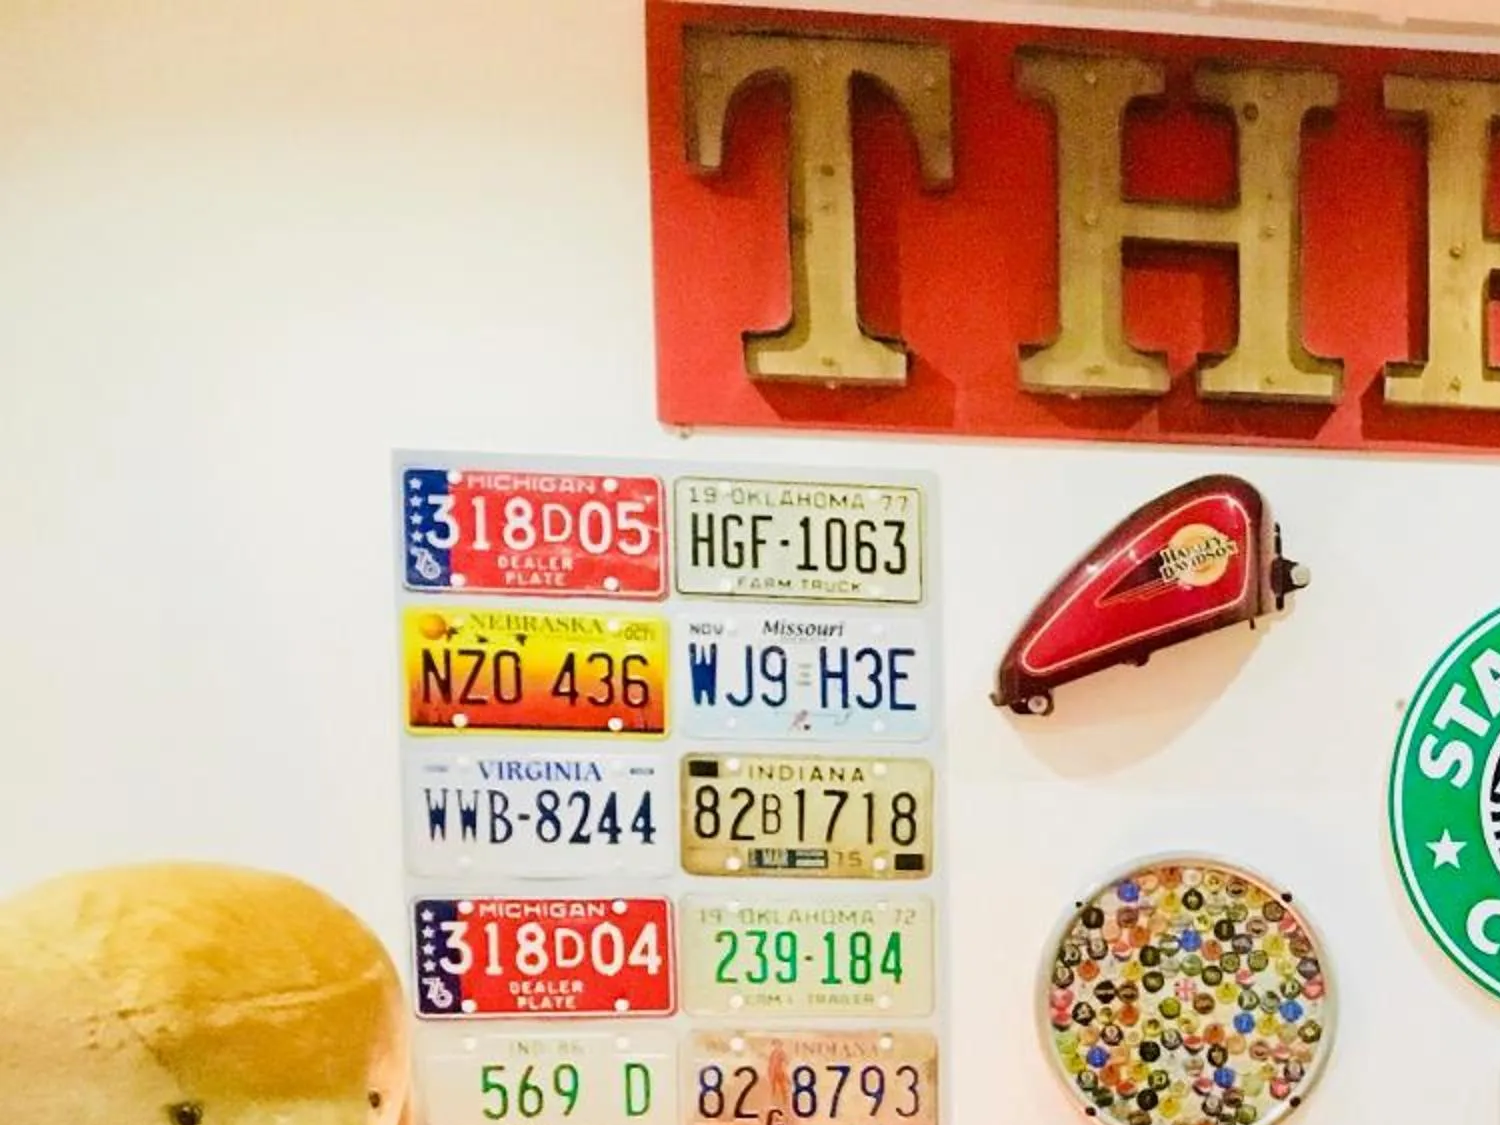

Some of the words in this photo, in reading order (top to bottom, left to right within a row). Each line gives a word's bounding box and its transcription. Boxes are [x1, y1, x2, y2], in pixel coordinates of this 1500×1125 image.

[467, 475, 596, 493] MICHIGAN
[689, 486, 717, 504] 19
[731, 490, 865, 509] OKLAHOMA
[881, 495, 907, 512] 77
[427, 495, 650, 555] 318D05
[691, 512, 906, 575] HGF-1063
[498, 556, 573, 570] DEALER
[506, 572, 567, 585] PLATE
[737, 577, 791, 589] FARM
[801, 580, 862, 593] TRUCK
[470, 614, 603, 634] NEBRASKA
[690, 624, 724, 635] NOV
[762, 620, 845, 637] Missouri
[551, 651, 651, 708] 436
[688, 643, 788, 708] WJ9
[819, 646, 917, 710] H3E
[478, 760, 602, 781] VIRGINIA
[748, 764, 866, 783] INDIANA
[424, 788, 656, 844] WWB-8244
[694, 784, 918, 846] 82B1718
[480, 903, 605, 918] MICHIGAN
[741, 909, 874, 924] OKLAHOMA
[440, 922, 662, 976] 318D04
[715, 931, 903, 984] 239-184
[509, 980, 584, 994] DEALER
[517, 996, 576, 1009] PLATE
[793, 1041, 877, 1057] INDIANA
[482, 1063, 579, 1120] 569
[625, 1062, 650, 1116] D
[699, 1064, 760, 1120] 82
[791, 1063, 920, 1120] 8793
